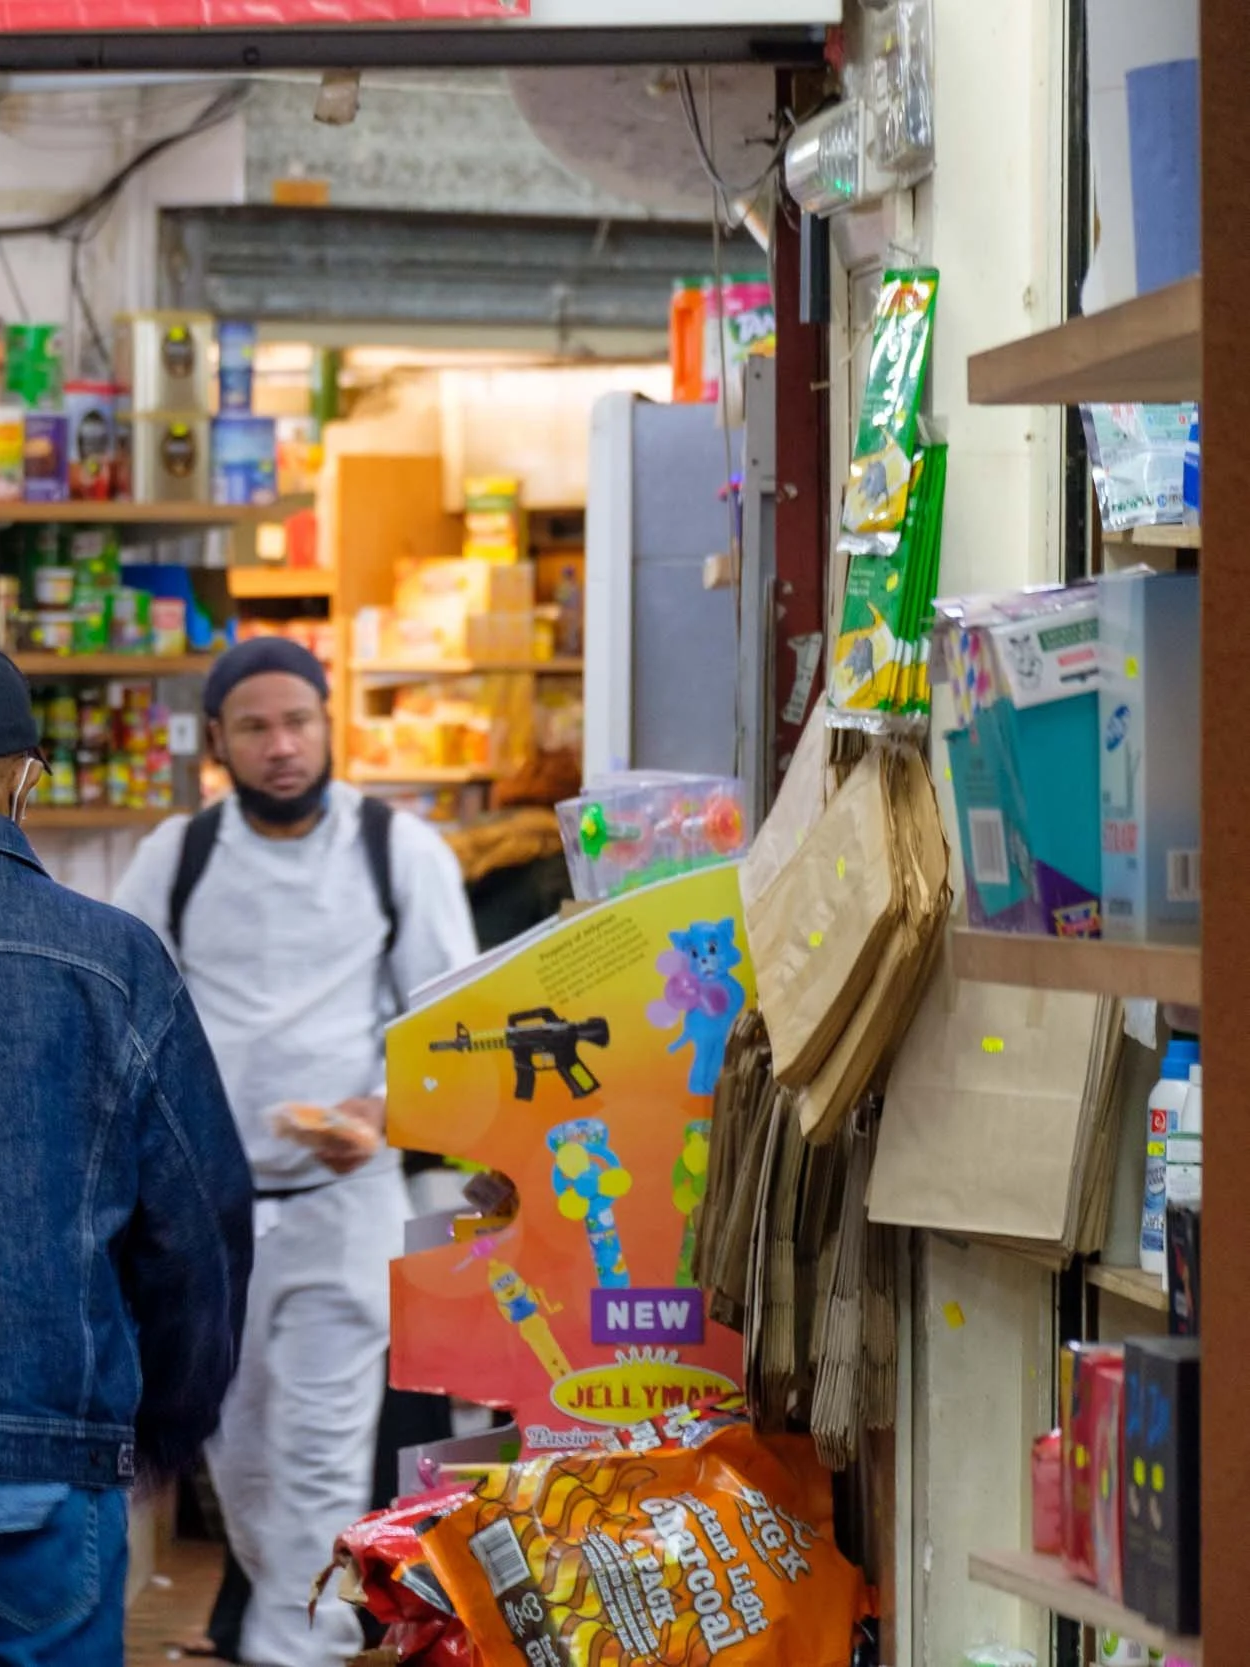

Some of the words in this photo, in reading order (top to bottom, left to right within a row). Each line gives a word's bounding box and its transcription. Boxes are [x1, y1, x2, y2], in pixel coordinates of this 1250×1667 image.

[606, 1300, 690, 1331] NEW
[741, 1486, 787, 1548] BIG
[777, 1545, 811, 1584] K
[632, 1554, 678, 1630] PACK
[638, 1497, 746, 1655] Charcoal
[727, 1562, 770, 1636] Light
